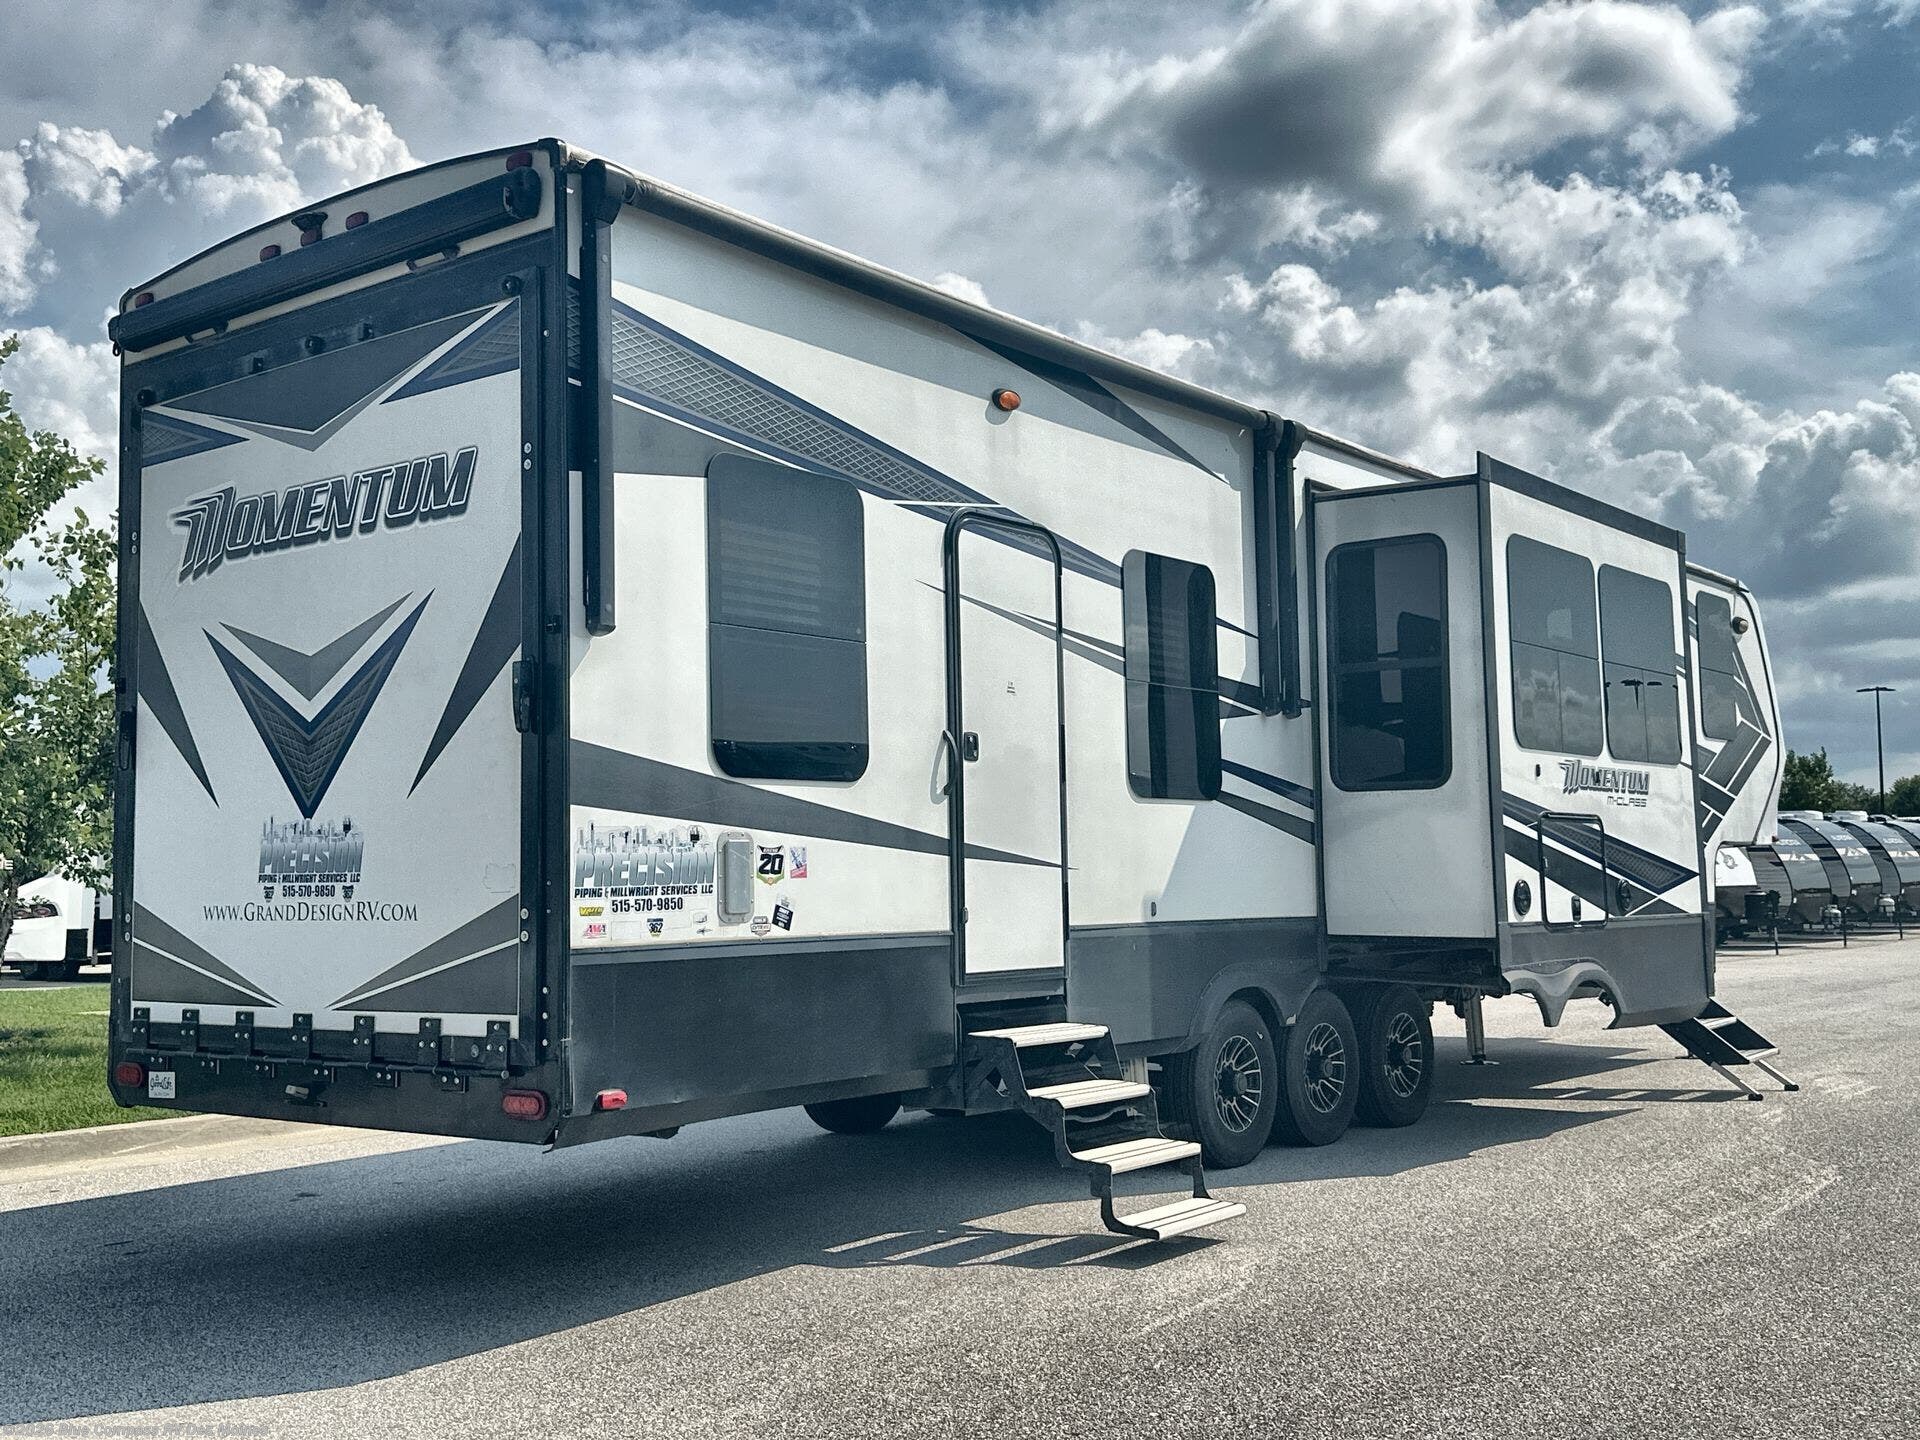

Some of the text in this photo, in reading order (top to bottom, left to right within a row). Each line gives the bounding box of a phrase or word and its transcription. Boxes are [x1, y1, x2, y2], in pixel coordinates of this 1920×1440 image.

[170, 446, 478, 584] MOMENTUM
[1559, 760, 1649, 796] MOMENTUM
[259, 841, 364, 873] PRECISION
[574, 850, 715, 887] PRECISION
[758, 853, 785, 876] 20
[258, 874, 278, 883] PIPING
[282, 874, 317, 883] MILLWRIGHT
[318, 873, 347, 882] SERVICES
[349, 873, 360, 882] LLC
[282, 885, 336, 898] 515-570-9850
[574, 887, 603, 899] PIPING
[610, 885, 659, 897] MILLWRIGHT
[661, 885, 698, 895] SERVICES
[701, 884, 714, 894] LLC
[611, 897, 684, 913] 515-570-9850
